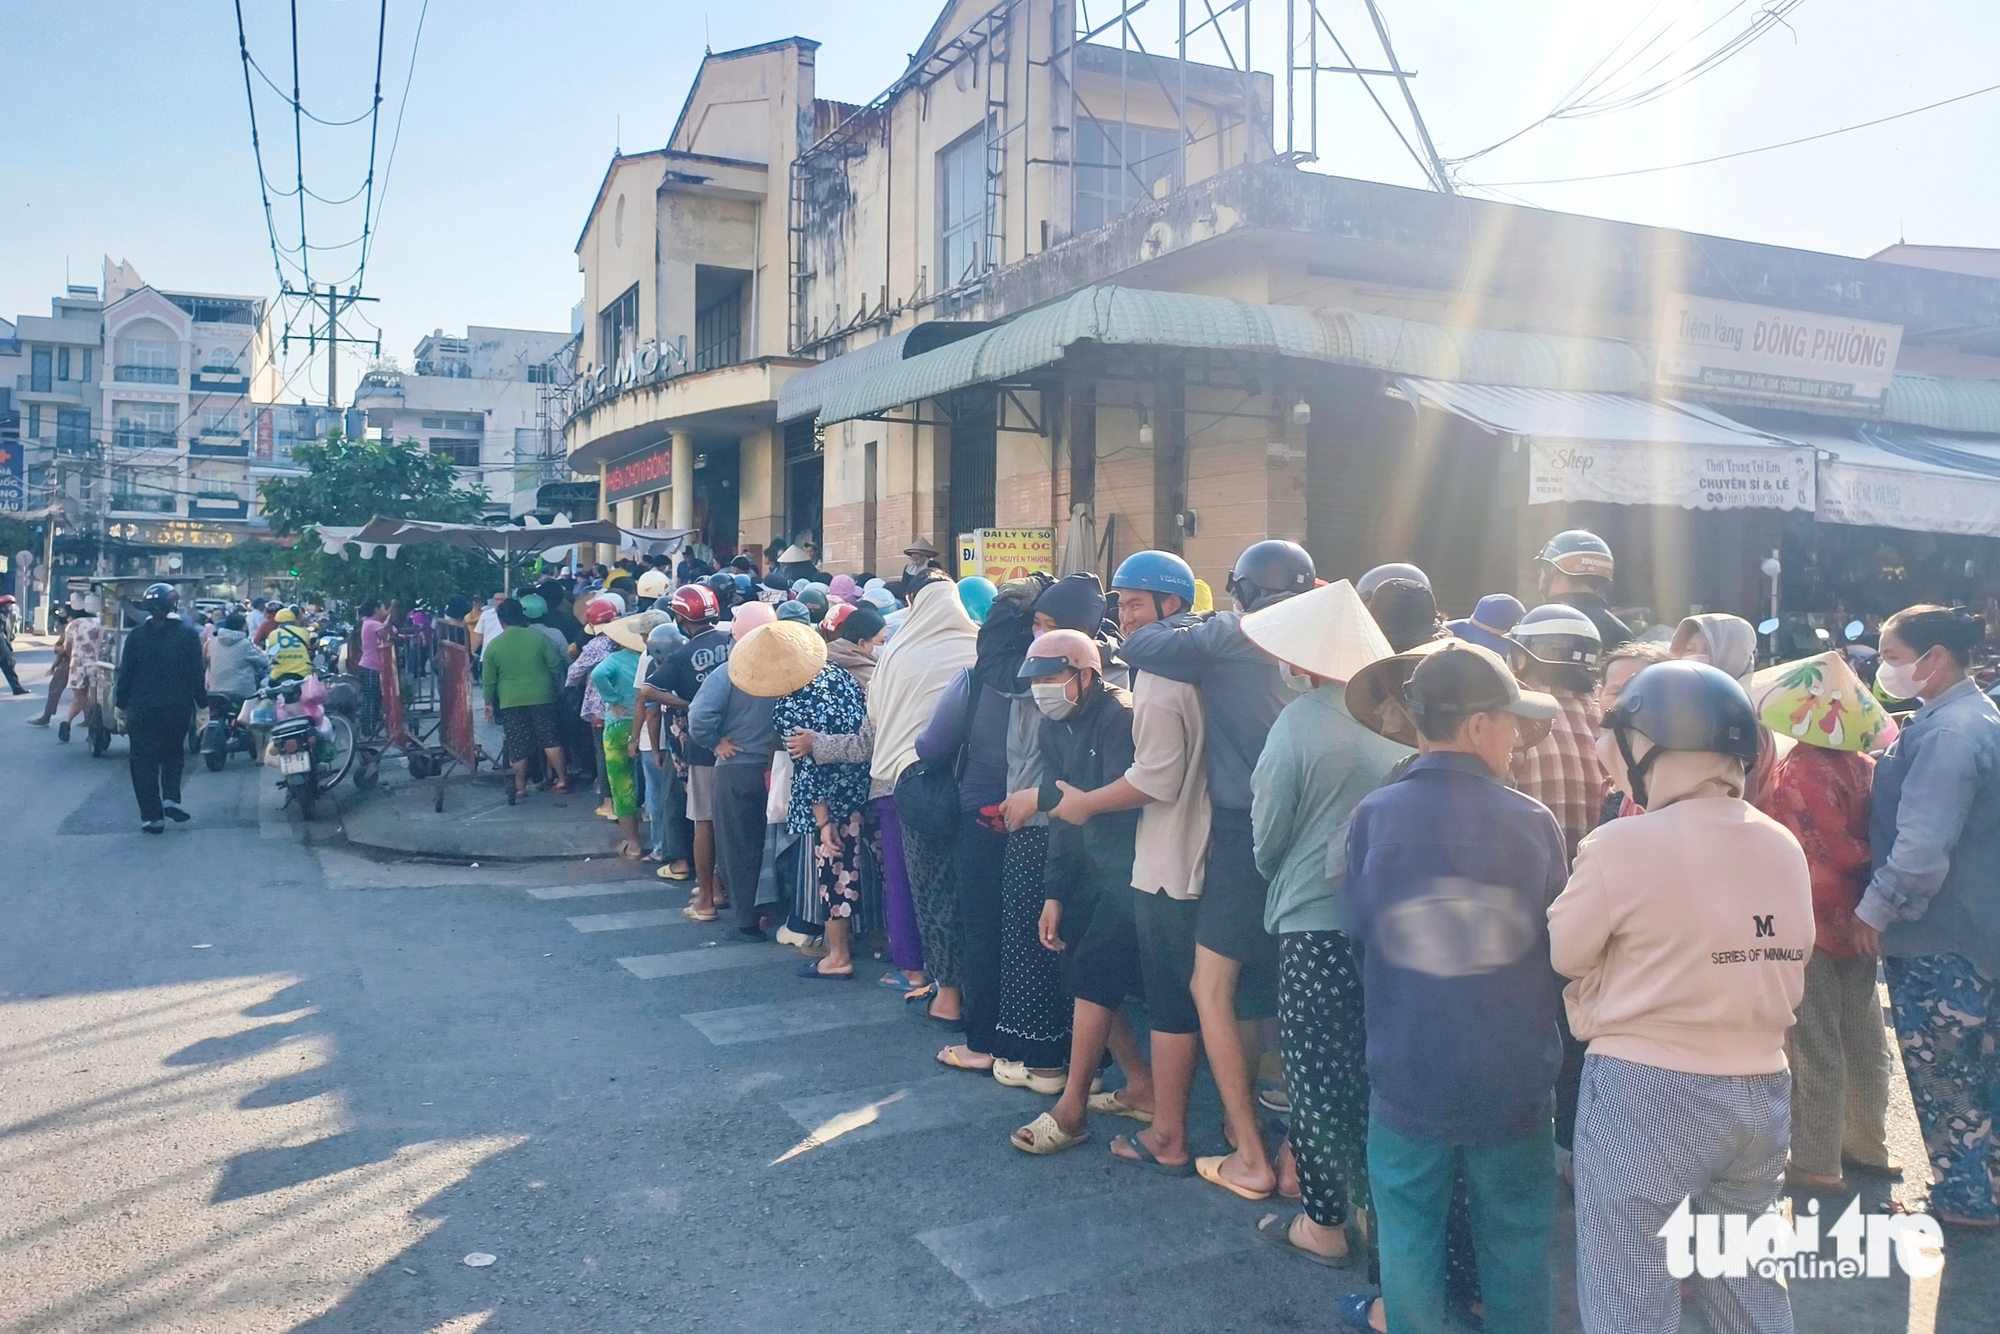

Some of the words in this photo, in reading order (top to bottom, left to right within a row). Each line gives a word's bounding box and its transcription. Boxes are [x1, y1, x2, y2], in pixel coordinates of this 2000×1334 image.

[1713, 313, 1744, 352] Vàng
[1752, 315, 1808, 358] ĐÔNG
[1810, 325, 1887, 368] PHƯƠNG
[614, 335, 688, 388] MÔN
[1550, 447, 1594, 476] Shop
[1766, 460, 1781, 474] Em
[1699, 477, 1747, 490] CHUYÊN
[1763, 479, 1773, 490] &
[1752, 915, 1776, 938] M
[1711, 950, 1747, 965] SERIES
[1748, 949, 1762, 962] OF
